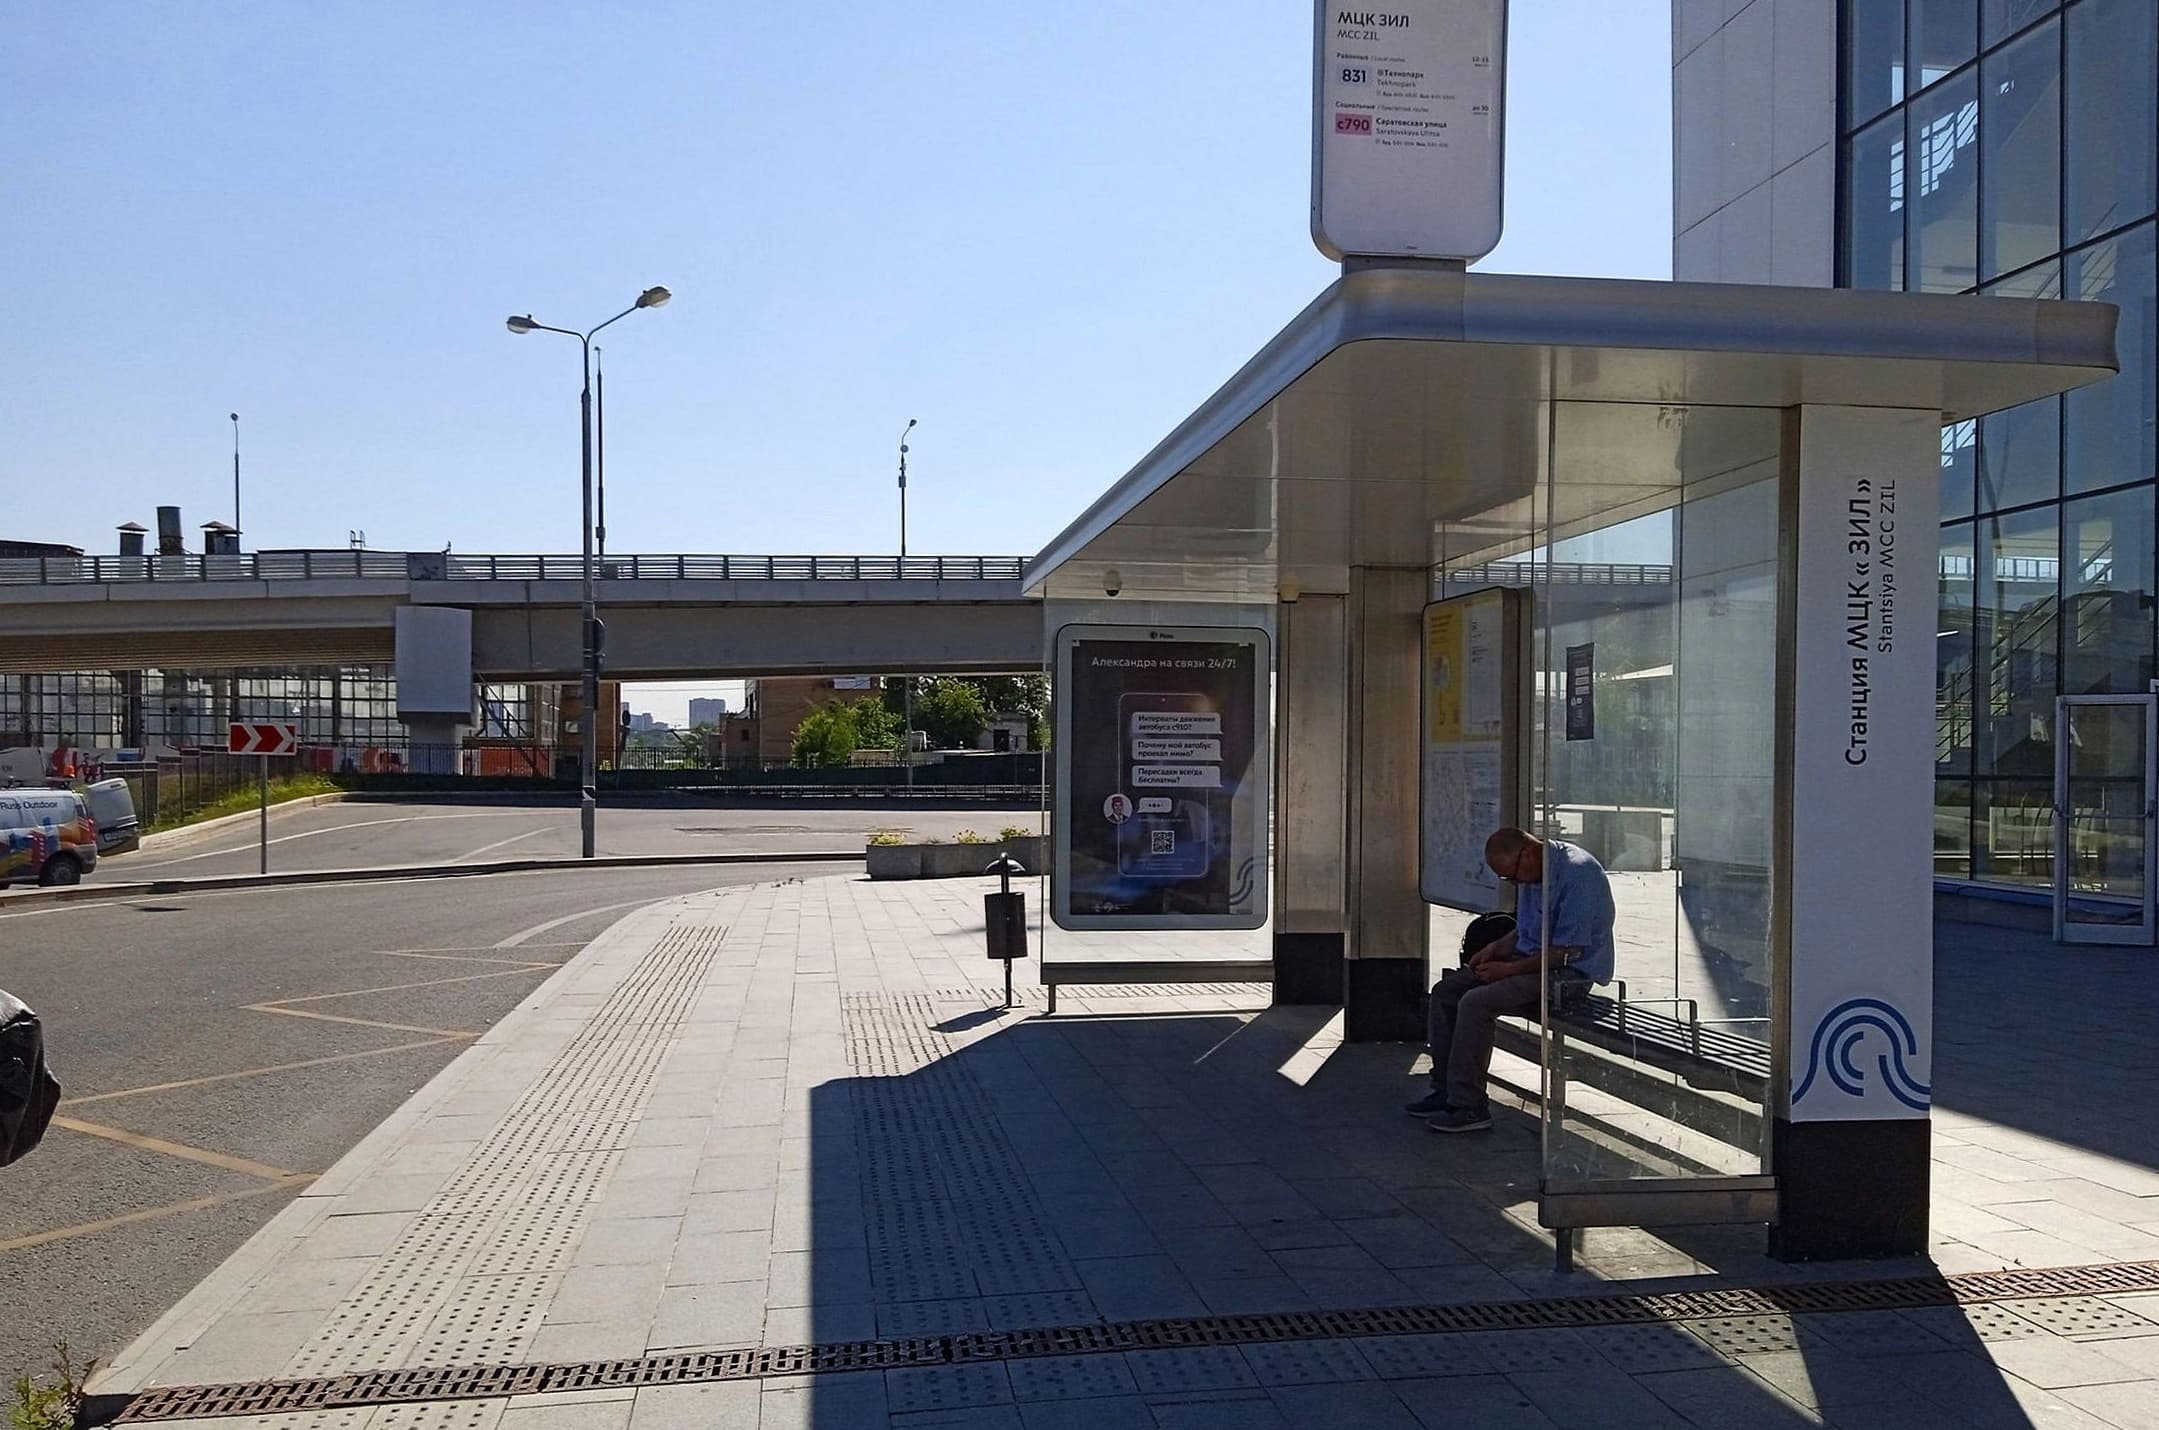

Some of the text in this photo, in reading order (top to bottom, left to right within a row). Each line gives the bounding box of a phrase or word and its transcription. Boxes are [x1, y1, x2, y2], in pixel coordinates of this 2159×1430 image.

[1337, 11, 1409, 28] МЦК ЗИЛ
[1337, 29, 1380, 41] MCC ZIL
[1342, 68, 1424, 83] 831 Технопарк
[1337, 118, 1370, 132] с790
[1376, 117, 1423, 128] Саратовская
[1878, 480, 1896, 652] Stantsiya MCC ZIL
[1847, 581, 1873, 651] МЦК
[1091, 656, 1237, 669] Александра на связи 24/7!
[1845, 658, 1872, 765] Станция
[1138, 715, 1179, 723] Интервалы
[1138, 723, 1170, 732] автобуса
[1138, 741, 1166, 750] Почему
[1184, 742, 1212, 750] автобус
[1138, 768, 1178, 776] Пересадки
[23, 801, 58, 809] Outdoor
